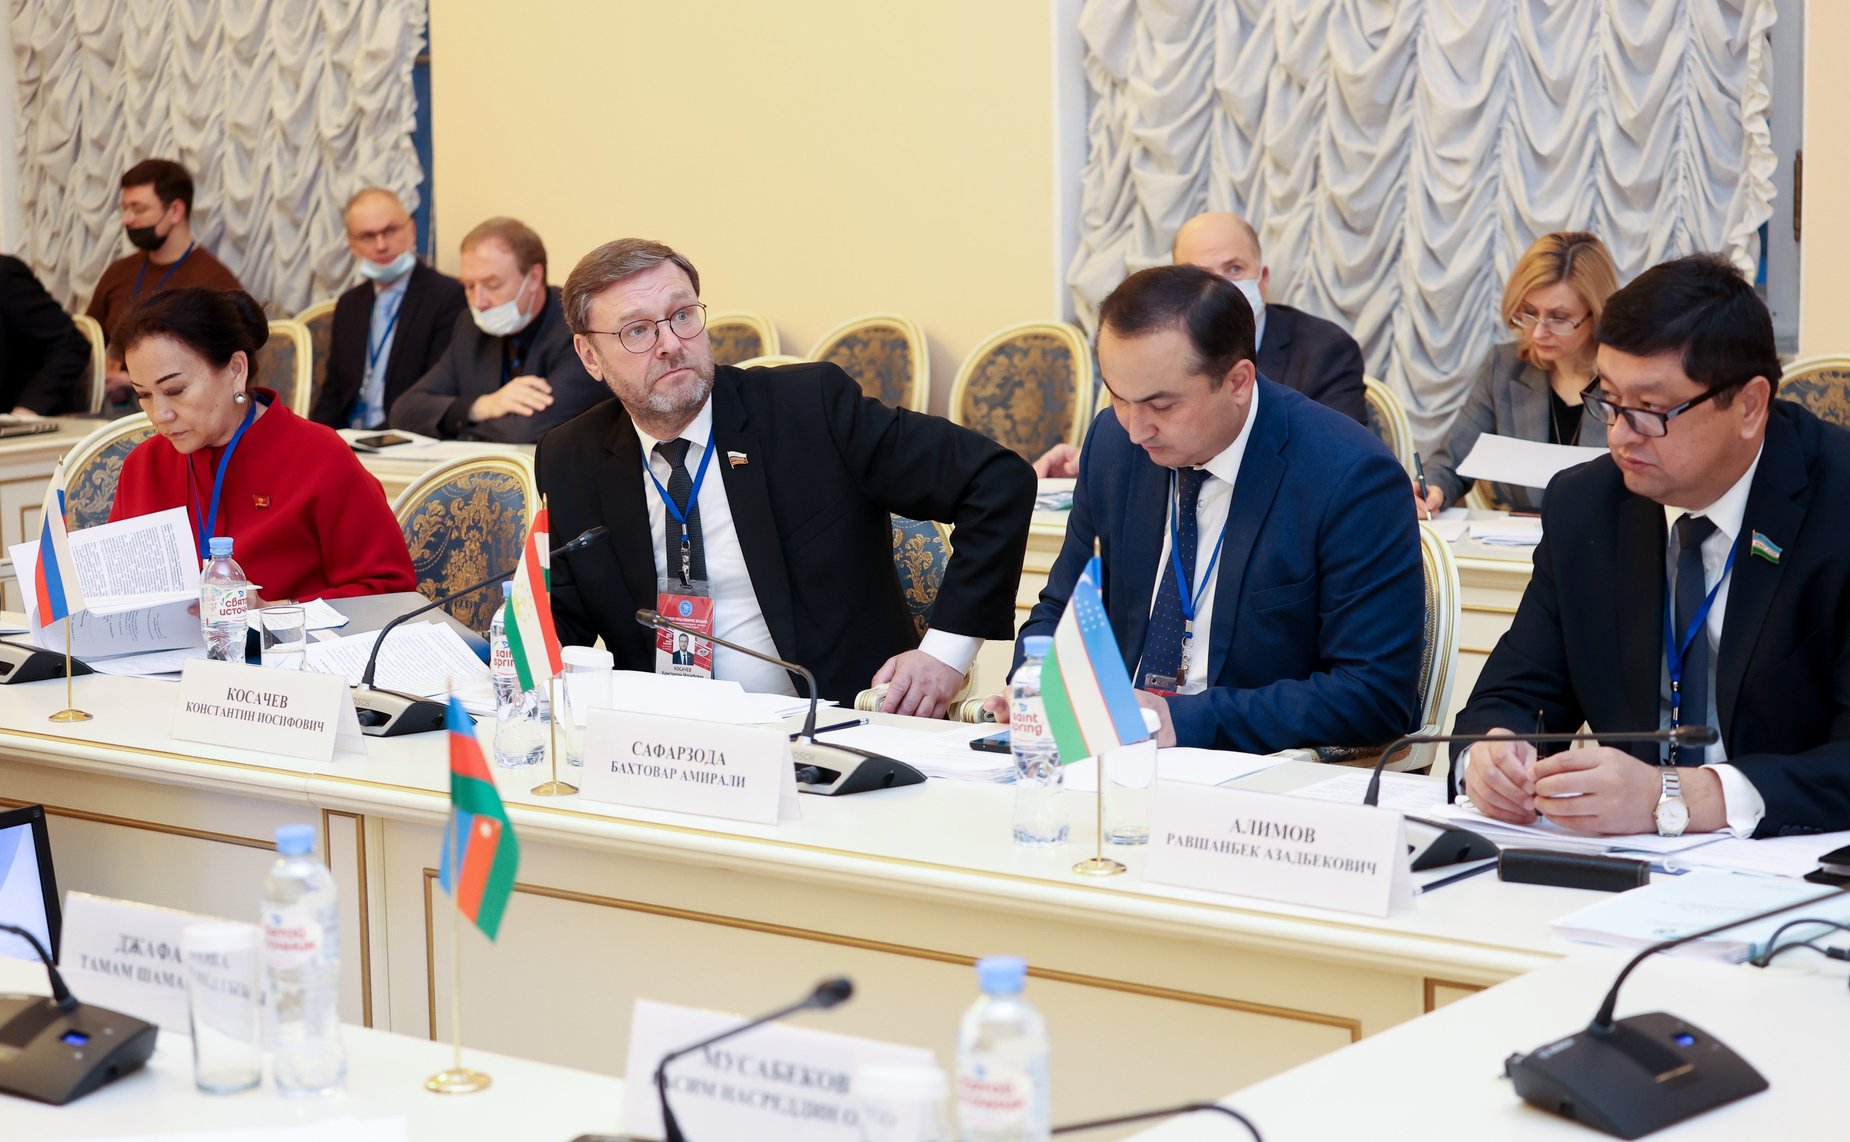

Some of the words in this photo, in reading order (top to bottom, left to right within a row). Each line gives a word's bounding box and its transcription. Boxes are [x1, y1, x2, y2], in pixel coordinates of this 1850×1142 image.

[226, 687, 288, 709] КОСАЧЕВ
[353, 696, 371, 707] OSCH
[186, 701, 255, 722] КОНСТАНТИН
[257, 712, 325, 732] ИОСИФОВИЧ
[1012, 722, 1042, 737] pring
[632, 740, 726, 766] САФАРЗОДА
[611, 760, 677, 780] БАХТОВАР
[679, 769, 746, 788] АМИРАЛИ
[1230, 818, 1316, 844] АЛИМОВ
[1166, 832, 1261, 858] РАВШАНБЕК
[1264, 848, 1377, 875] АЗАДБЕКОВИЧ
[80, 953, 134, 980] ТАМАМ
